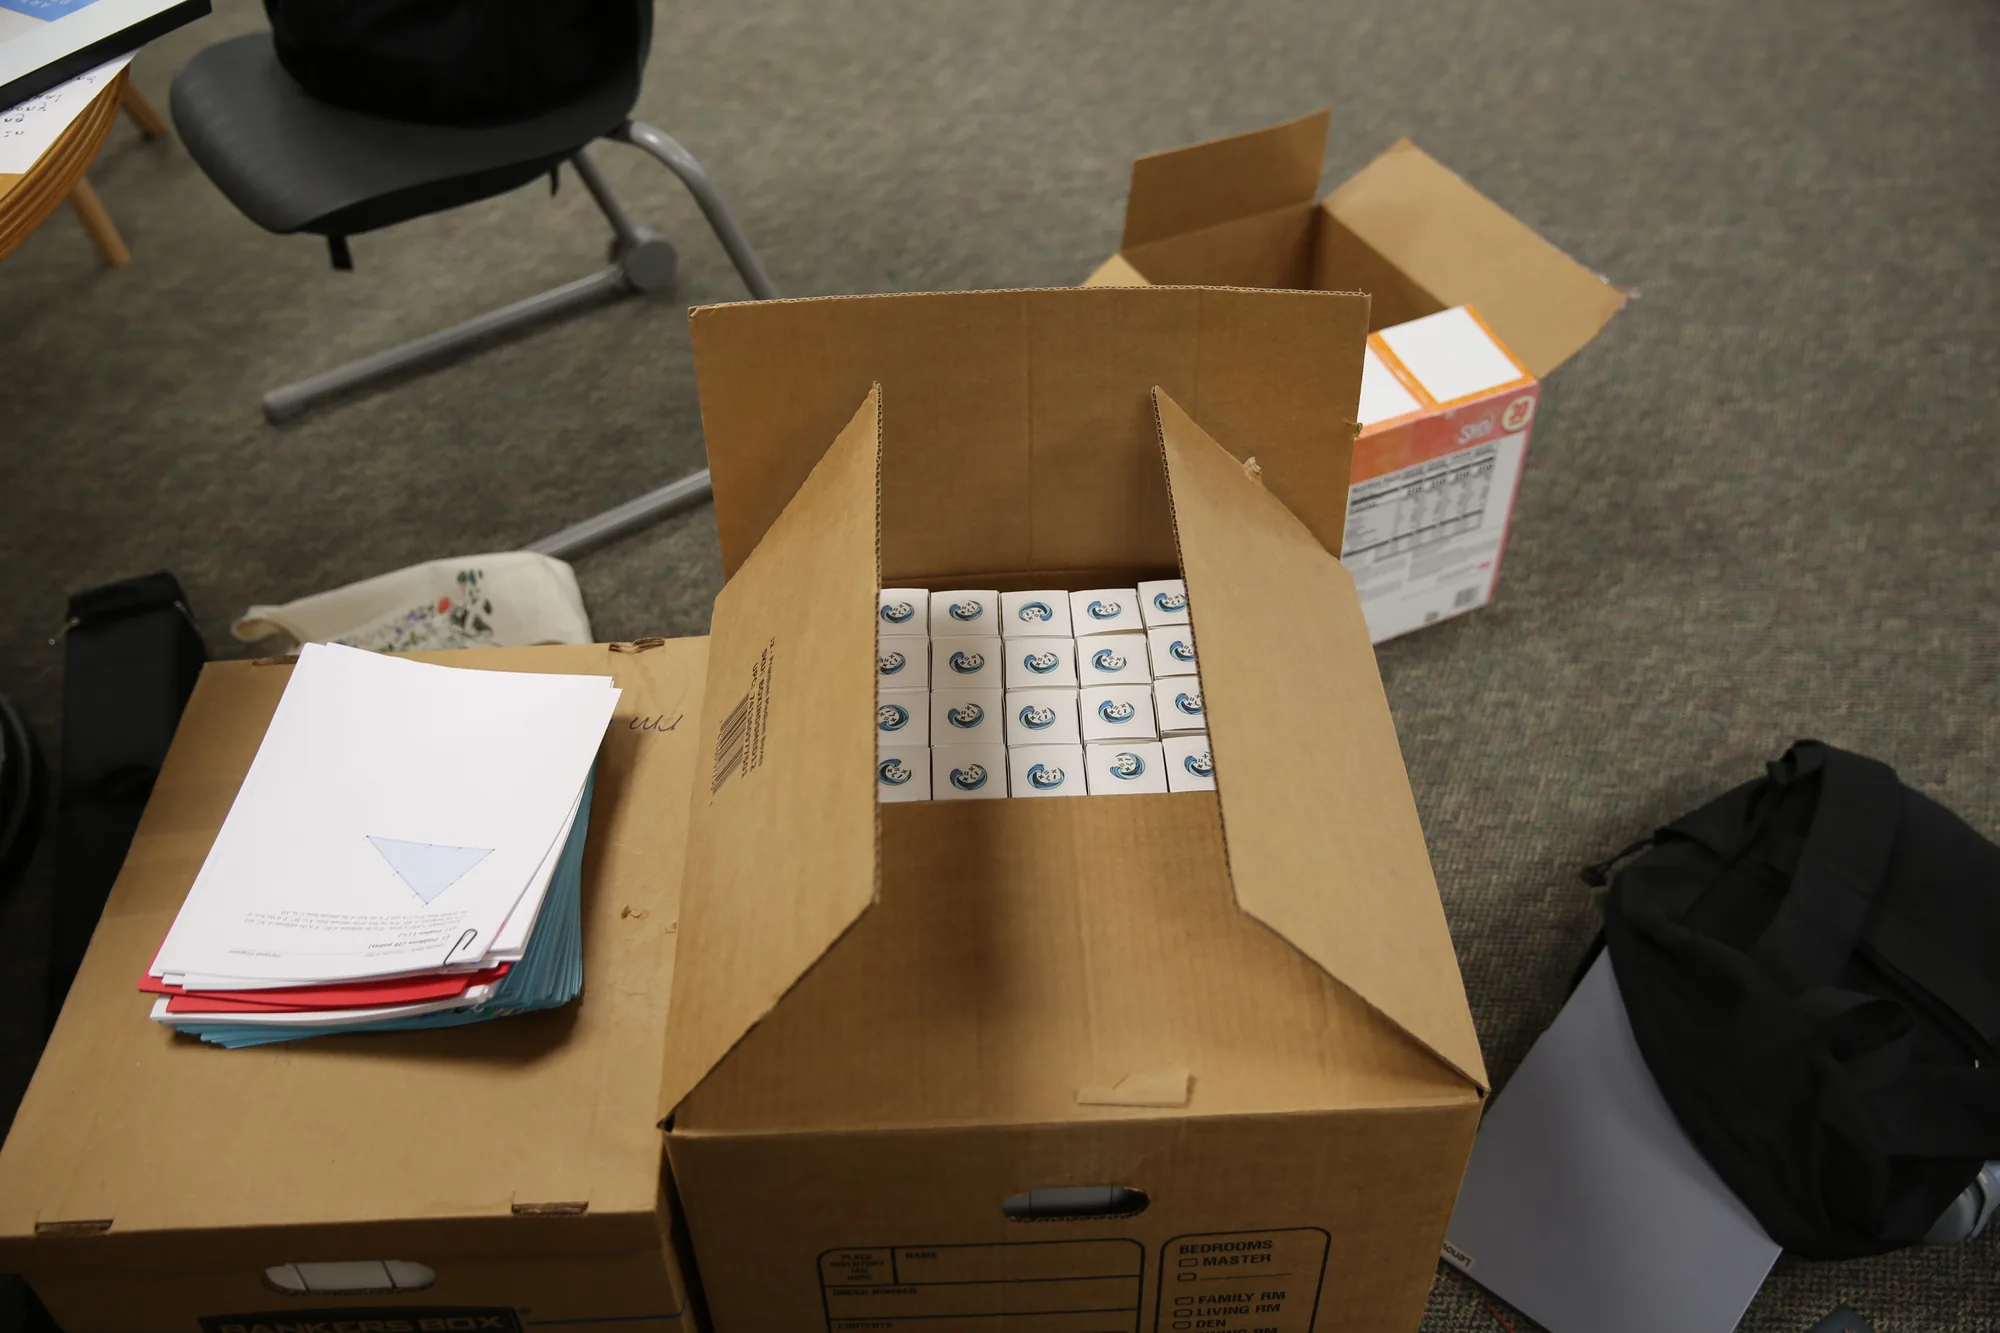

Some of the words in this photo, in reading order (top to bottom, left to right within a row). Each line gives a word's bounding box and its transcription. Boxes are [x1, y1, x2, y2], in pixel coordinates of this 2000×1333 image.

[1179, 1240, 1272, 1254] BEDROOMS
[905, 1252, 937, 1260] NAME
[1203, 1254, 1271, 1266] MASTER
[1198, 1293, 1254, 1304] FAMILY
[1260, 1290, 1286, 1301] RM
[1197, 1305, 1249, 1316] LIVING
[1255, 1303, 1281, 1313] RM
[219, 1320, 413, 1333] BANKERS
[418, 1316, 505, 1332] BOX
[1196, 1318, 1227, 1328] DEN
